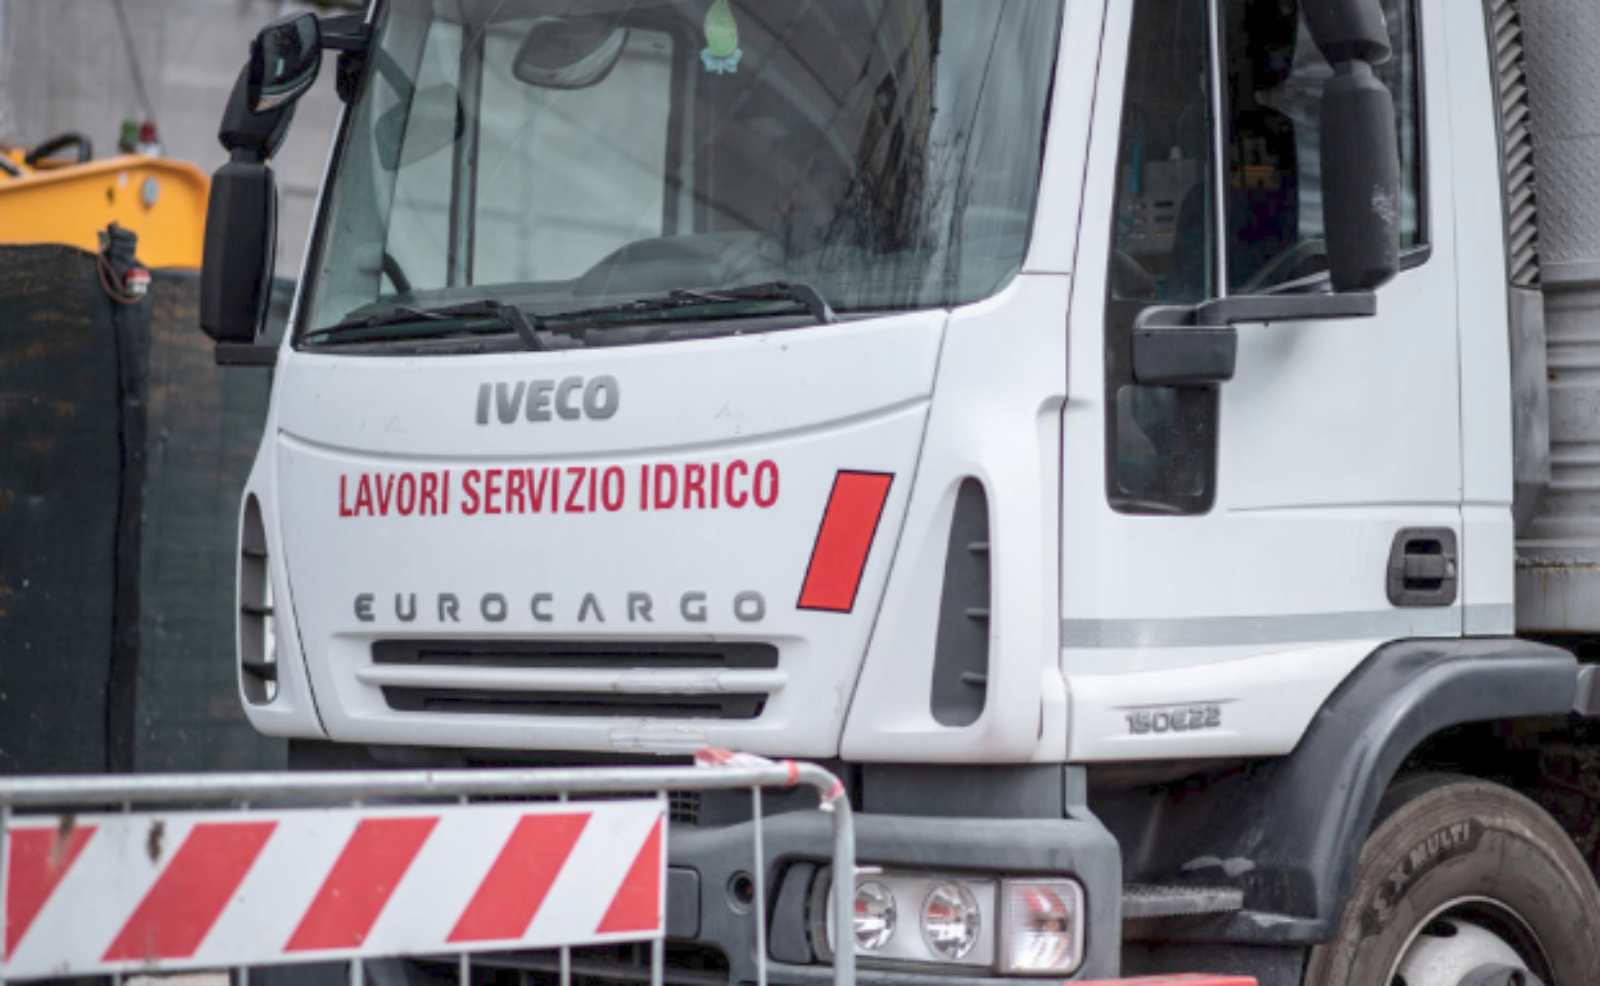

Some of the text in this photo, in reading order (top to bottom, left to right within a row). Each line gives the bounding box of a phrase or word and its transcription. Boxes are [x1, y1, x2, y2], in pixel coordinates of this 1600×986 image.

[475, 375, 620, 425] IVECO
[338, 459, 780, 517] LAVORI SERVIZIO IDRICO
[353, 590, 767, 622] EUROCARGO
[1408, 821, 1471, 870] MULTI
